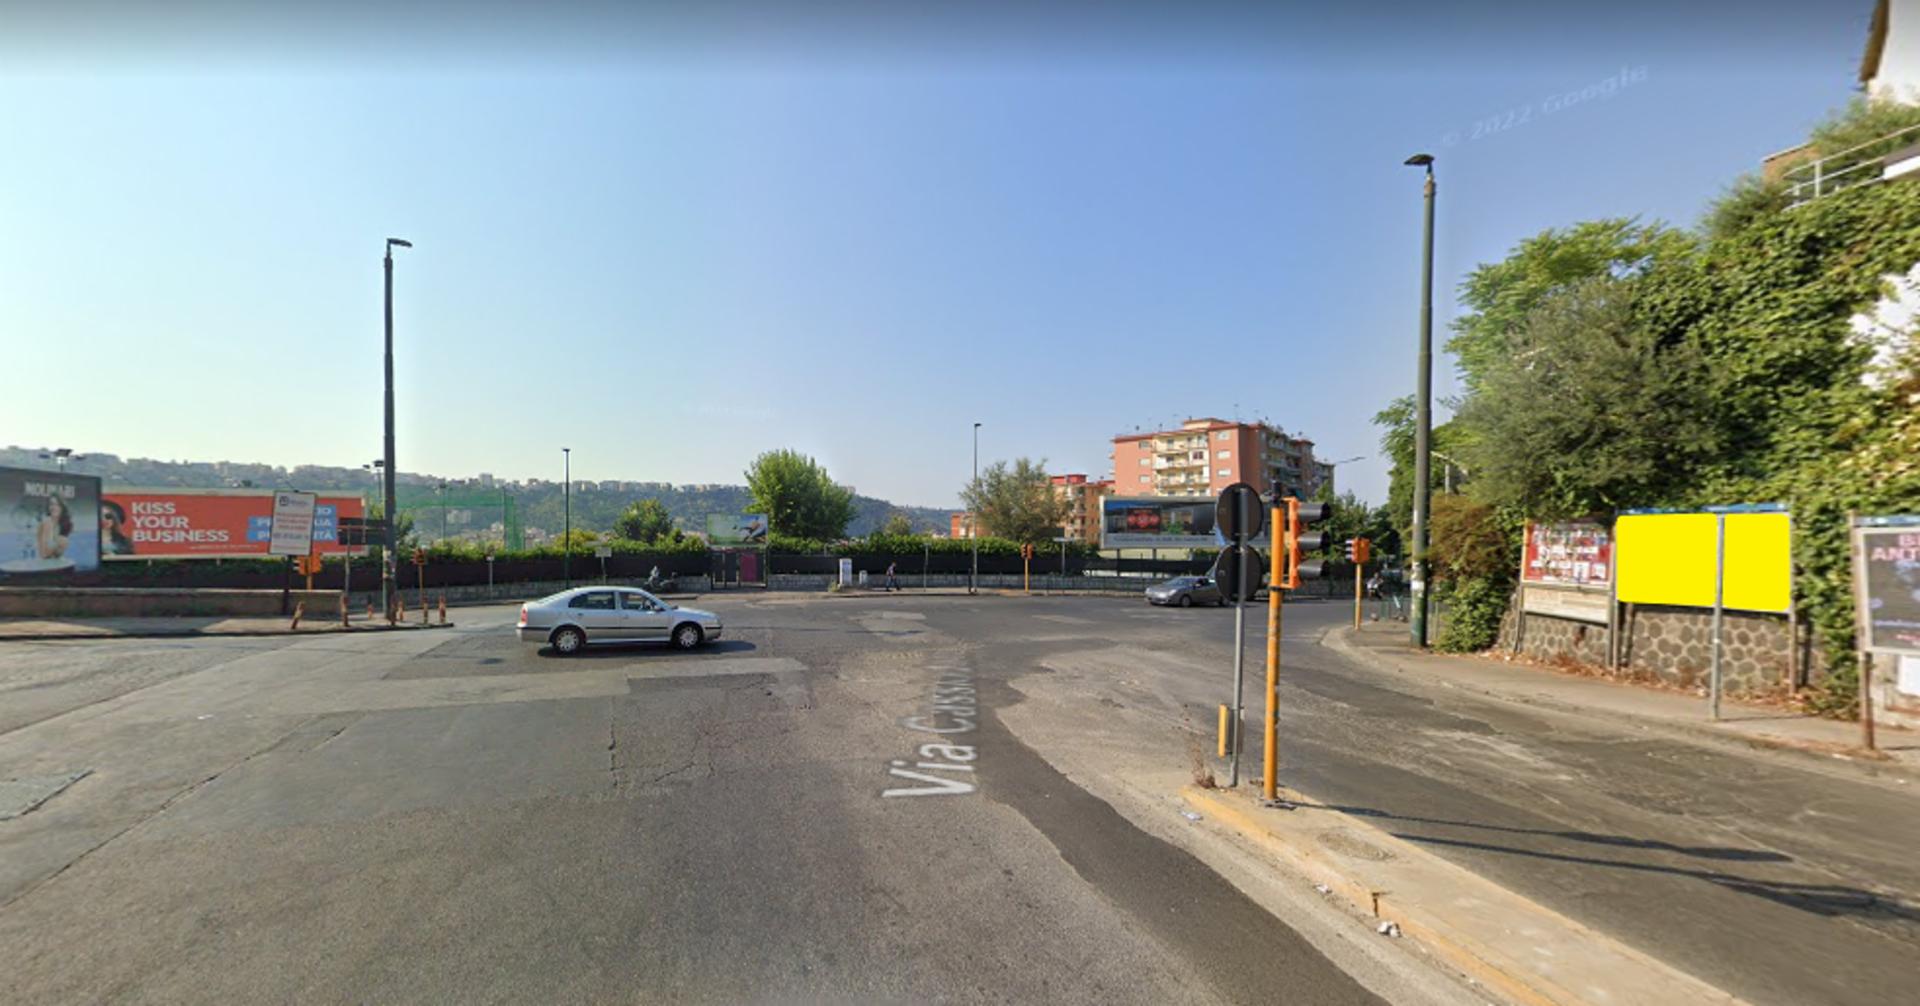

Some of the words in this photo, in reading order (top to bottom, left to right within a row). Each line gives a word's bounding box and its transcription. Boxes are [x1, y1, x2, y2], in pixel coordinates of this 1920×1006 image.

[131, 501, 176, 515] KISS
[131, 515, 190, 529] YOUR
[132, 529, 230, 543] BUSINESS
